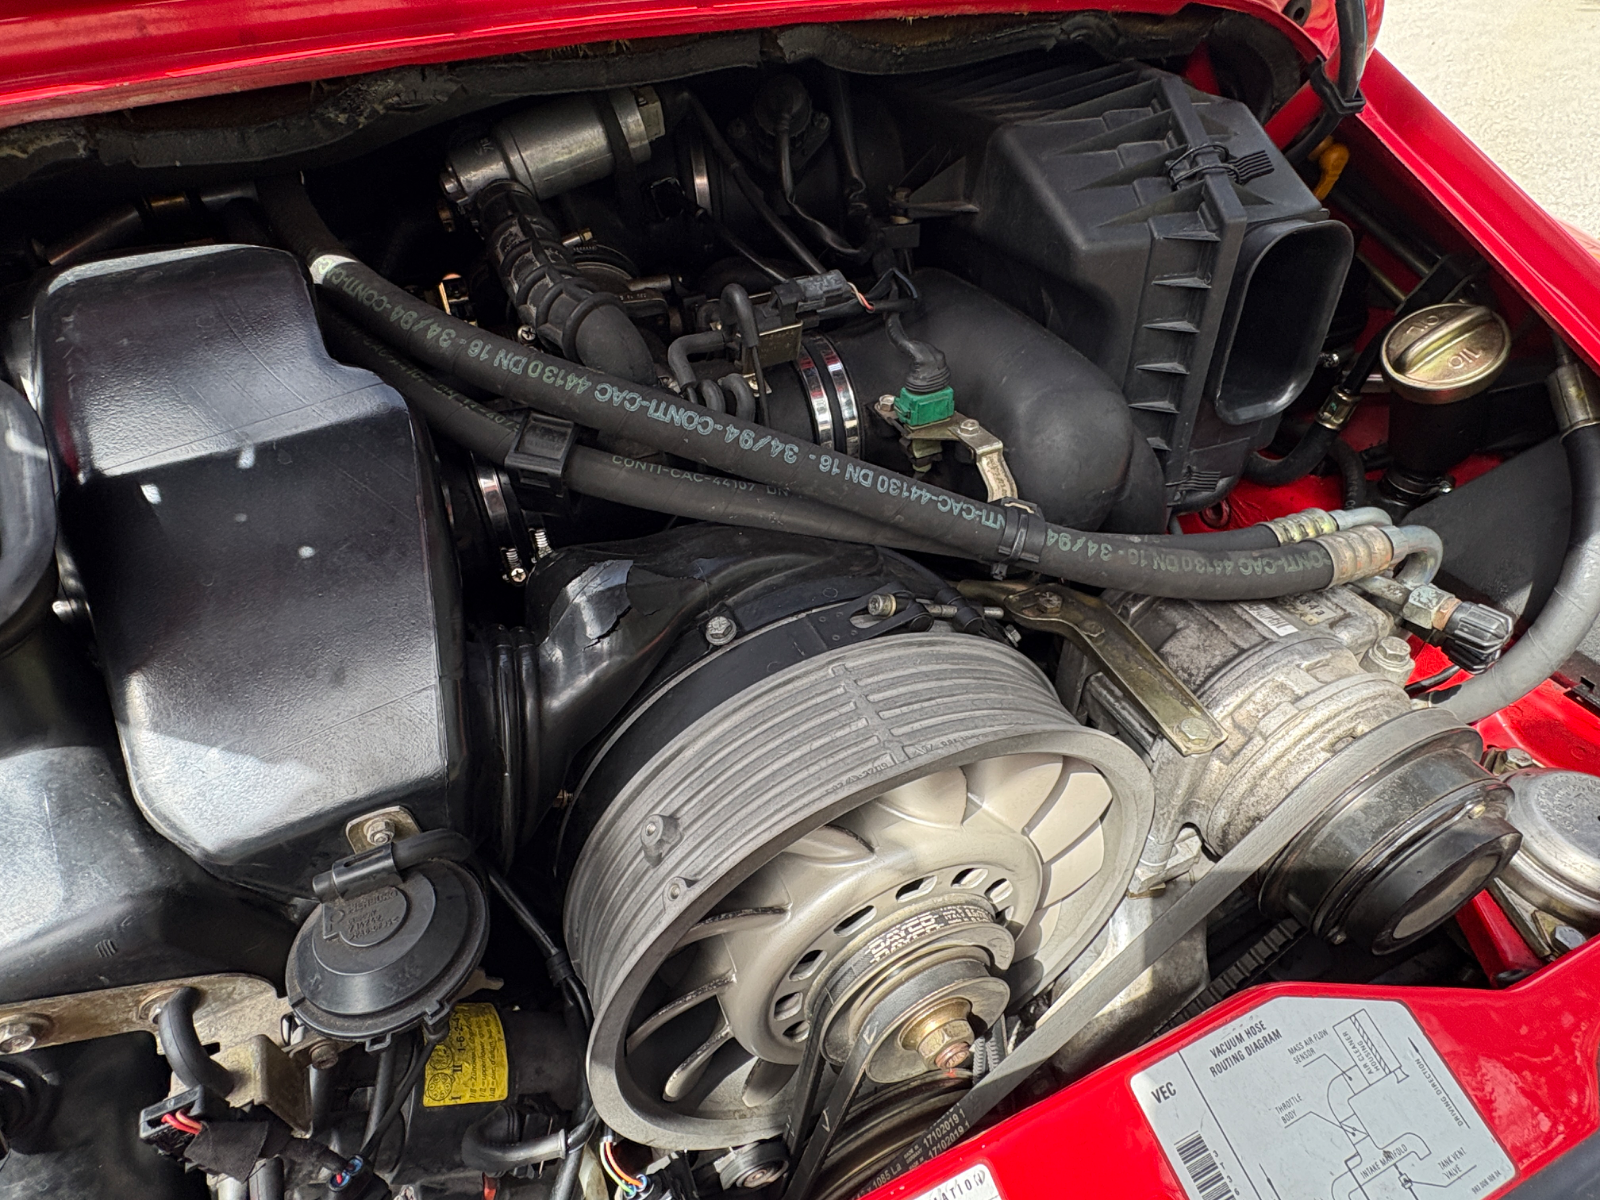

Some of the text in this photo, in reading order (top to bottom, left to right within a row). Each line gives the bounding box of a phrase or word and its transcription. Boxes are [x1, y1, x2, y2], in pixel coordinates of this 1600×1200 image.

[465, 336, 491, 362] 16
[492, 347, 528, 375] DN
[525, 358, 593, 396] 44130
[723, 422, 800, 464] 34/94
[817, 452, 842, 477] 16
[844, 462, 874, 488] DN
[867, 913, 936, 955] DAYCO
[1208, 1027, 1283, 1077] ROUTING DIAGRAM
[1209, 1019, 1267, 1059] VACUUM HOSE
[1286, 1026, 1329, 1056] MASS AIR FLOW
[1341, 1029, 1374, 1076] AIR CLEANER
[1292, 1046, 1316, 1065] SENSOR
[1356, 1039, 1381, 1072] HOUSING
[1150, 1080, 1178, 1105] VEC
[1274, 1092, 1303, 1115] THROTTLE
[1414, 1057, 1464, 1127] DRIVING DIRECTION
[921, 1112, 961, 1148] 17102019
[1280, 1108, 1298, 1124] BODY
[1358, 1142, 1409, 1179] INTAKE MANIFOLD
[1437, 1145, 1467, 1170] TANK VENT
[871, 1169, 892, 1189] 1085
[932, 1172, 984, 1200] ATION
[1441, 1163, 1463, 1181] VALVE
